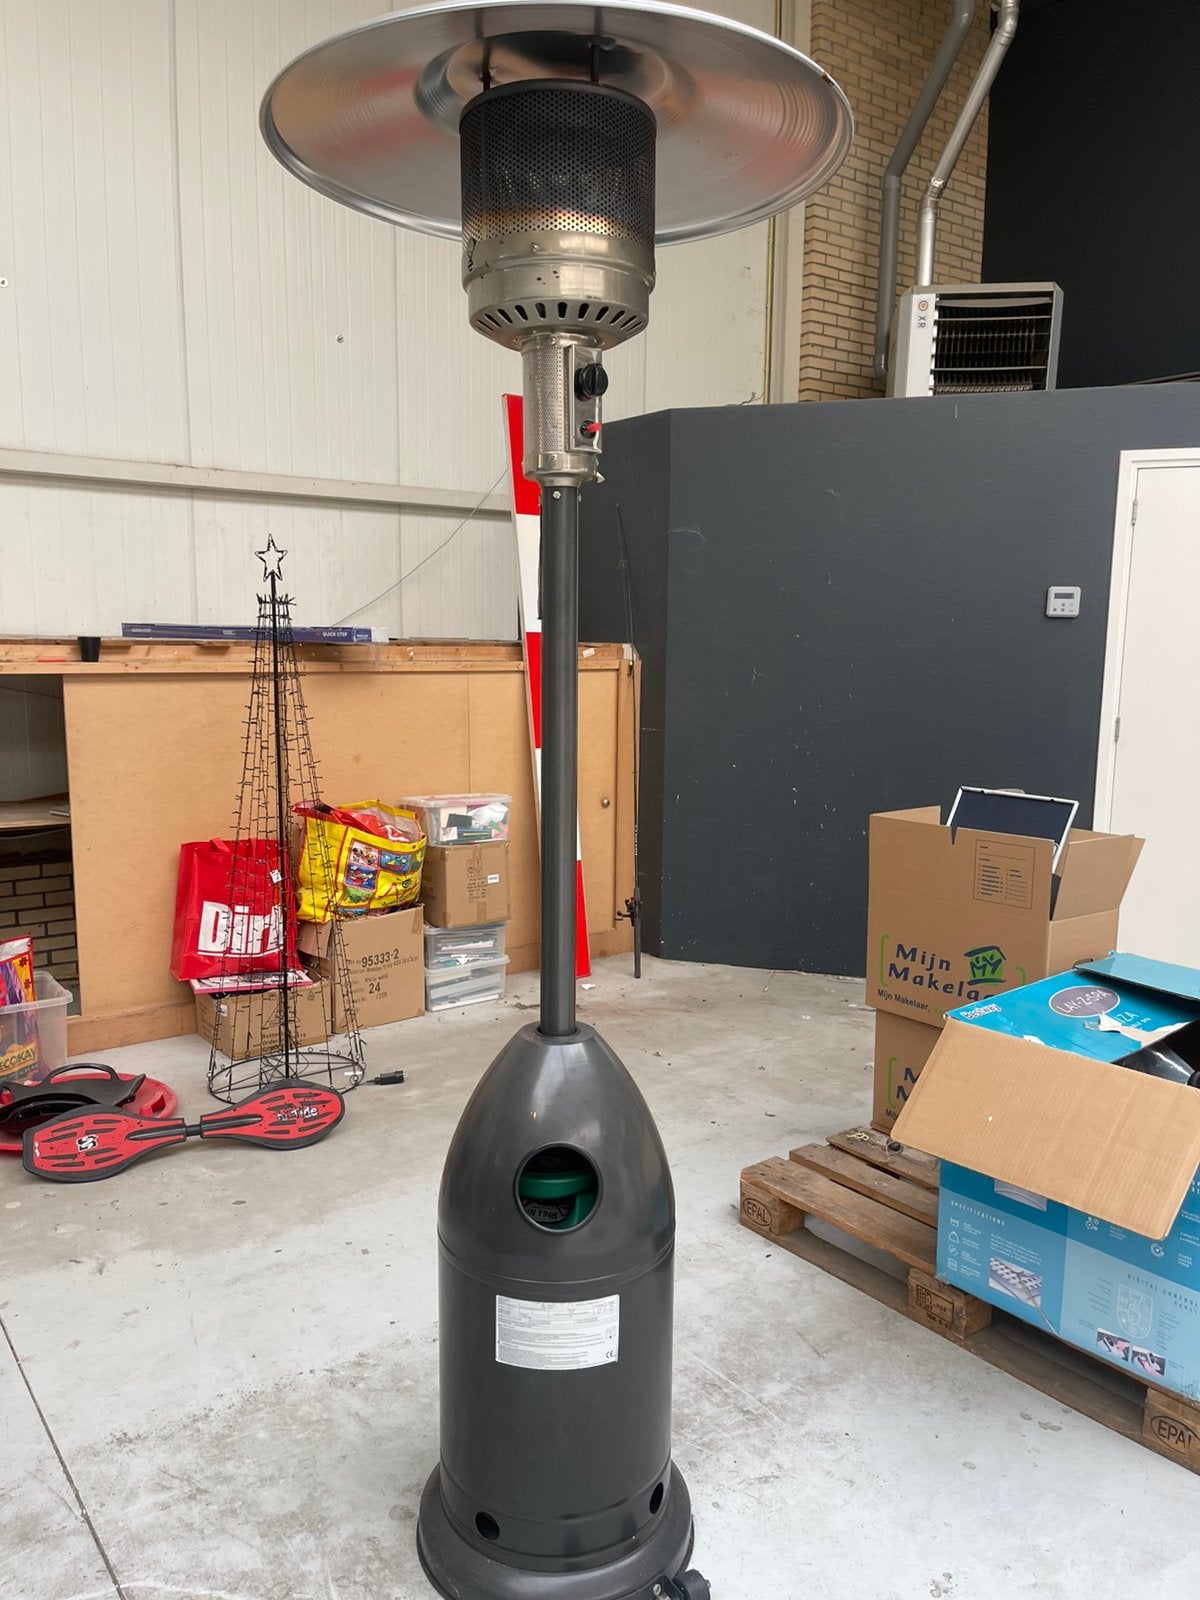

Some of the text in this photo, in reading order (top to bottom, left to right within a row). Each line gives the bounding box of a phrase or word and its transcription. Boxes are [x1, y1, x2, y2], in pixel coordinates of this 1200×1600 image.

[361, 948, 400, 968] 95333-2
[896, 943, 951, 972] Mijn
[368, 981, 381, 995] 24
[877, 988, 893, 1001] Mijn
[894, 993, 931, 1013] Makelaar,
[1056, 989, 1112, 1014] LAY-Z-SPA
[746, 1200, 768, 1224] EPAL
[951, 1200, 1005, 1226] SPECIFICATIONS
